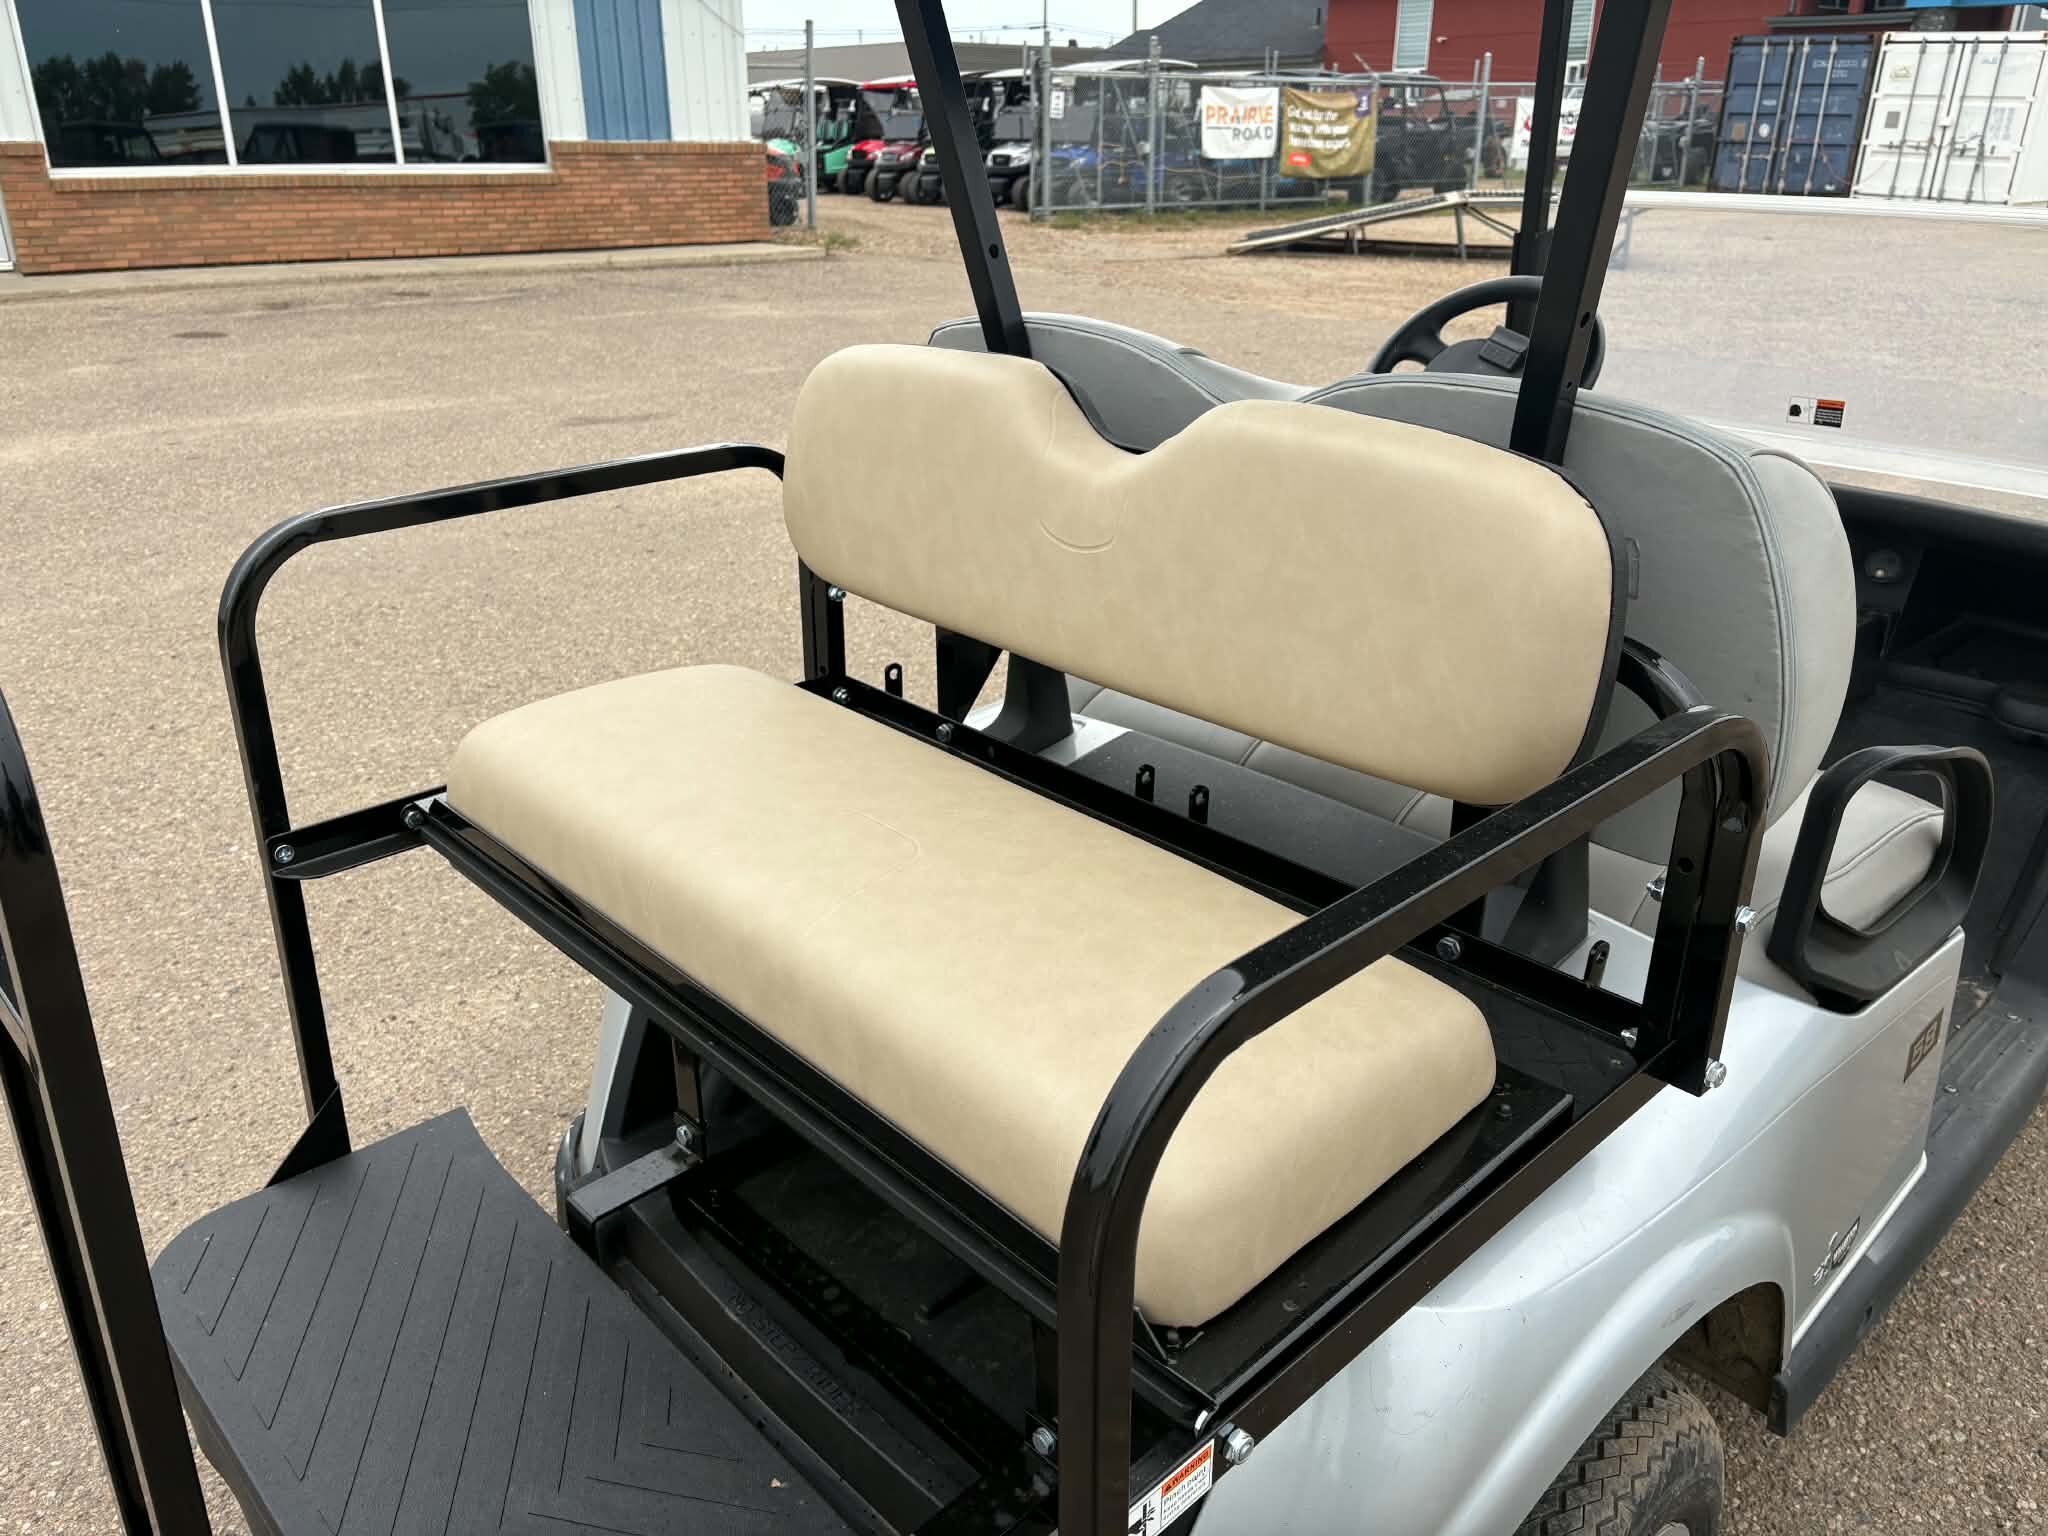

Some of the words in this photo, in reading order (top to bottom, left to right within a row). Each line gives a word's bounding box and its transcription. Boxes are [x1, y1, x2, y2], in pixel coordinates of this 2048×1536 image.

[1205, 104, 1274, 124] PRAIRIE
[1232, 127, 1274, 141] ROAD
[751, 1319, 801, 1354] STEP
[1172, 1451, 1209, 1484] WARNING
[1163, 1484, 1186, 1506] Pinch
